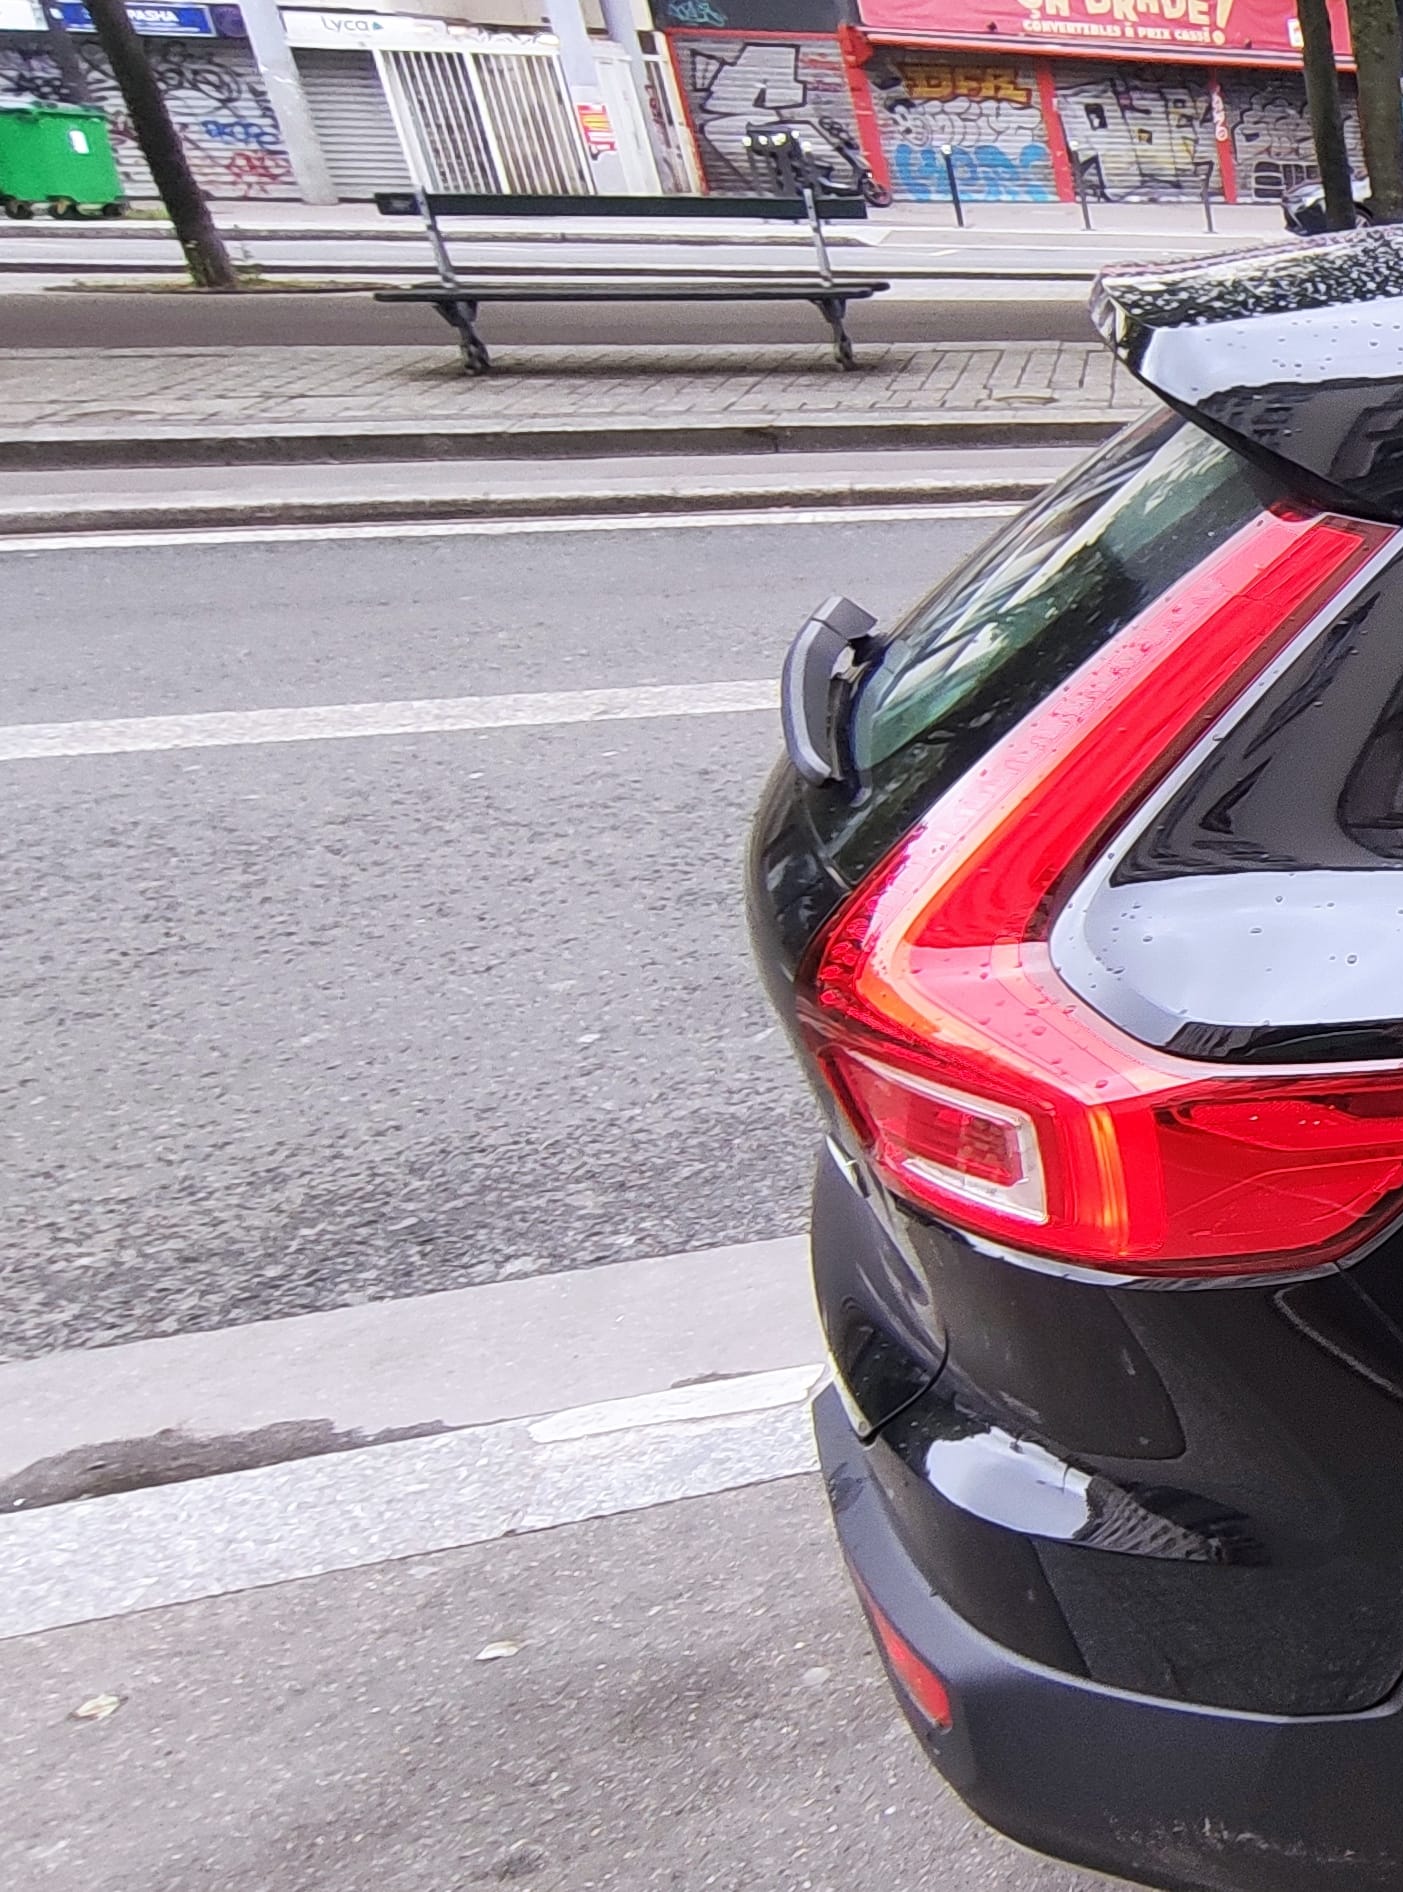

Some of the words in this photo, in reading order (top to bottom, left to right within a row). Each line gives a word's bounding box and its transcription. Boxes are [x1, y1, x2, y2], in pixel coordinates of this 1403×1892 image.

[320, 15, 369, 32] Lyca
[1022, 19, 1122, 37] CONVERTIBLES
[1137, 26, 1172, 39] PRIX
